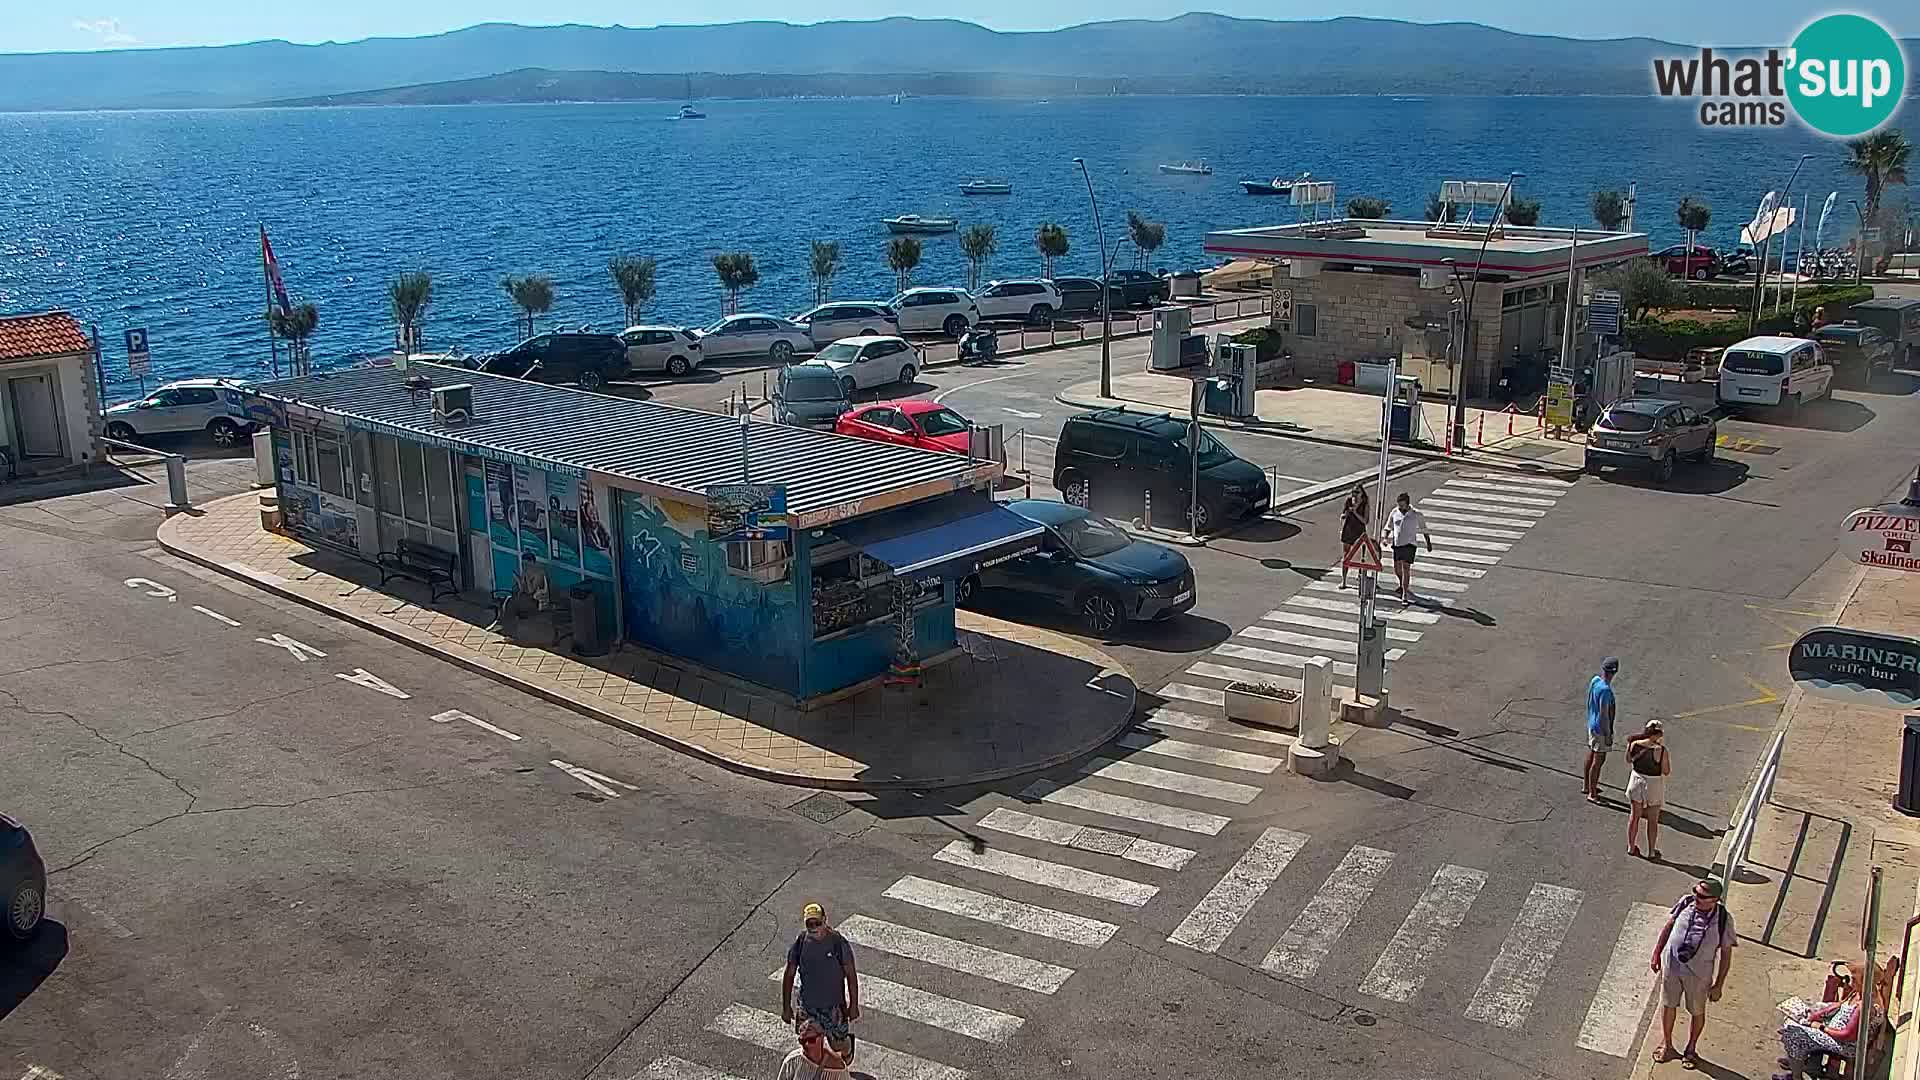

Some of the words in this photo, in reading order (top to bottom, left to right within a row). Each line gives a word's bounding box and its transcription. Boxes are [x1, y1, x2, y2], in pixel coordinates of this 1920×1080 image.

[131, 332, 142, 350] P
[1747, 351, 1765, 360] TAXI
[494, 450, 527, 465] STATION
[529, 457, 555, 471] TICKET
[556, 463, 584, 478] OFFICE
[1848, 515, 1920, 533] PIZZE
[1800, 643, 1920, 674] MARINER
[1829, 662, 1866, 674] caffe
[1871, 666, 1898, 681] bar
